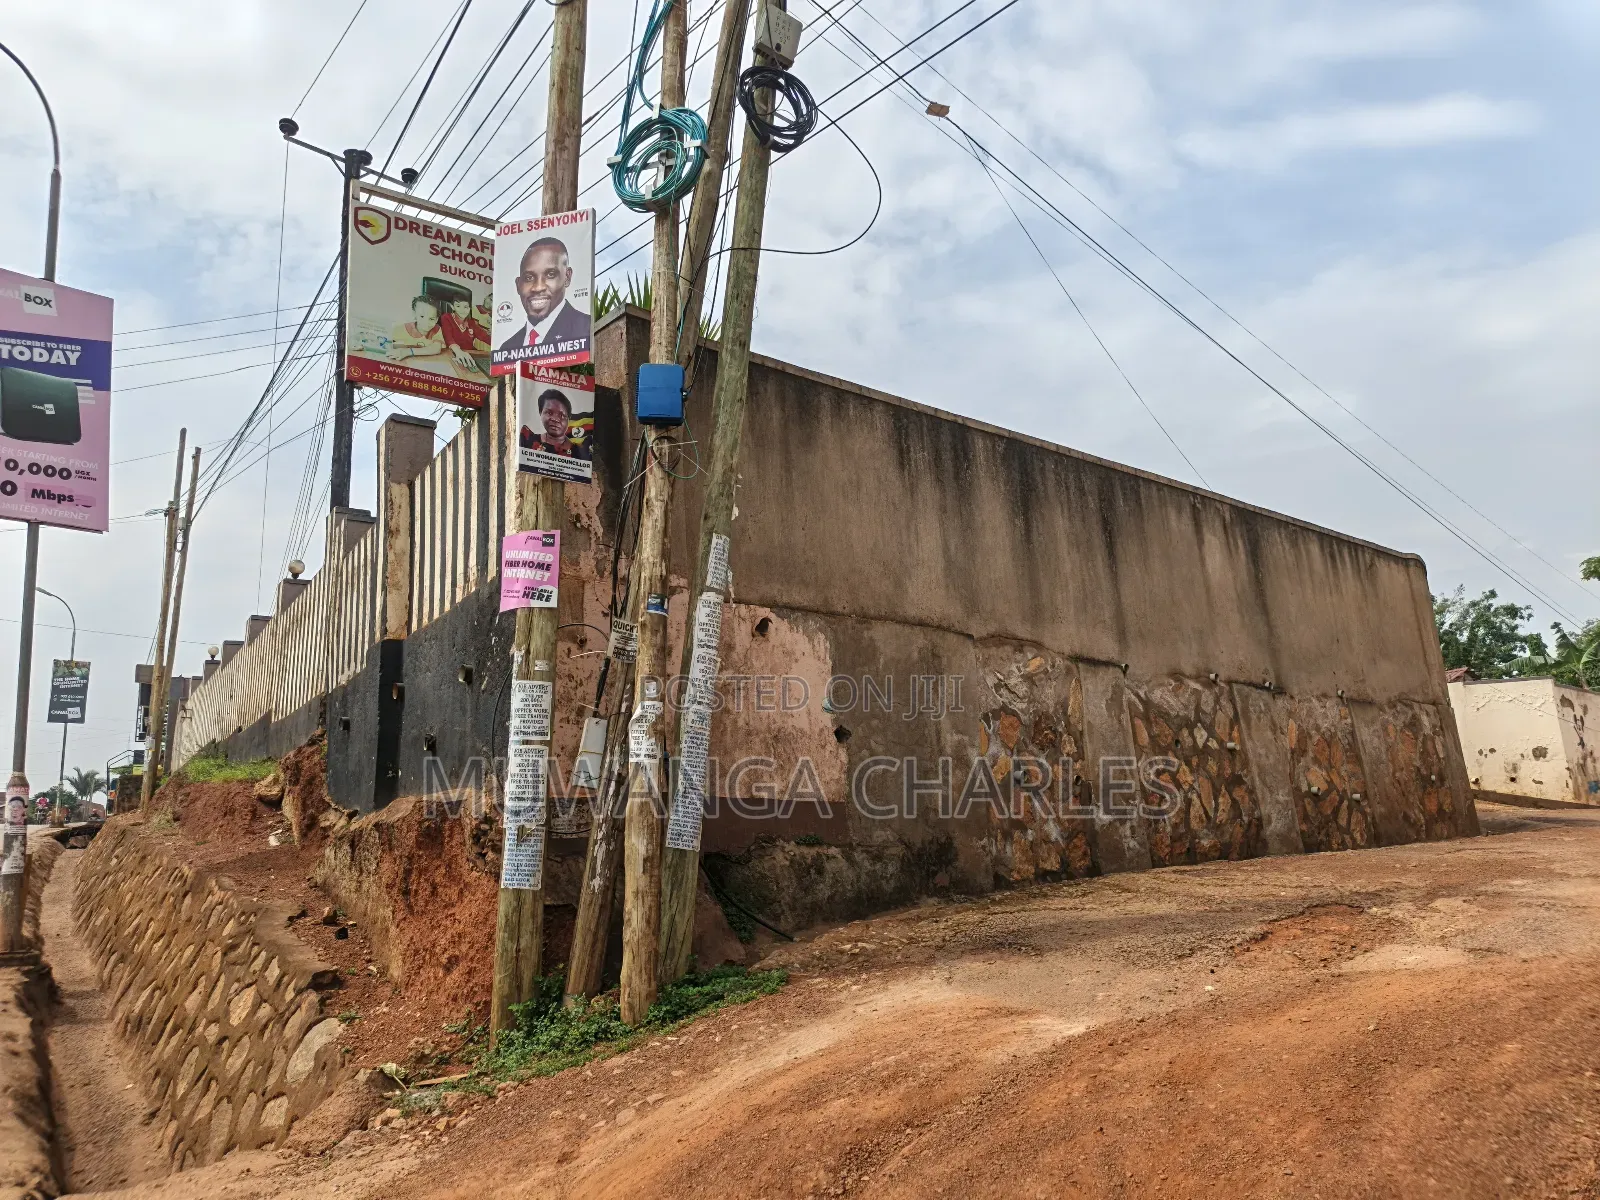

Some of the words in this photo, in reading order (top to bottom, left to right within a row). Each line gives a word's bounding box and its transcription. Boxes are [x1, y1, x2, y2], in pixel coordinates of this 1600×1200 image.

[394, 216, 462, 247] DREAM
[496, 223, 523, 237] JOEL
[526, 210, 589, 232] SSENYONYI
[429, 243, 494, 271] SCHOOL
[439, 262, 493, 285] BUKOTO
[24, 292, 53, 308] BOX
[0, 344, 82, 366] TODAY
[59, 344, 82, 352] FIBER
[493, 343, 556, 363] MP-NAKAWA
[557, 338, 587, 353] WEST
[528, 364, 588, 386] NAMATA
[365, 371, 390, 383] +256
[392, 376, 410, 387] 776
[412, 381, 429, 391] 888
[431, 386, 448, 395] 846
[458, 391, 481, 402] +256
[17, 449, 66, 464] STARTING
[69, 458, 99, 470] FROM
[535, 453, 557, 462] WOMAN
[557, 457, 591, 469] COUNCILLOR
[0, 457, 73, 481] 0,000
[75, 469, 91, 477] UGX
[31, 488, 75, 504] Mbps
[41, 507, 90, 521] INTERNET
[505, 550, 554, 562] UNLIMITED
[504, 560, 521, 568] FIBER
[521, 560, 552, 571] HOME
[503, 568, 551, 582] INTERNET
[522, 590, 552, 603] HERE
[523, 586, 554, 595] AVAILABLE
[613, 620, 635, 634] QUICK
